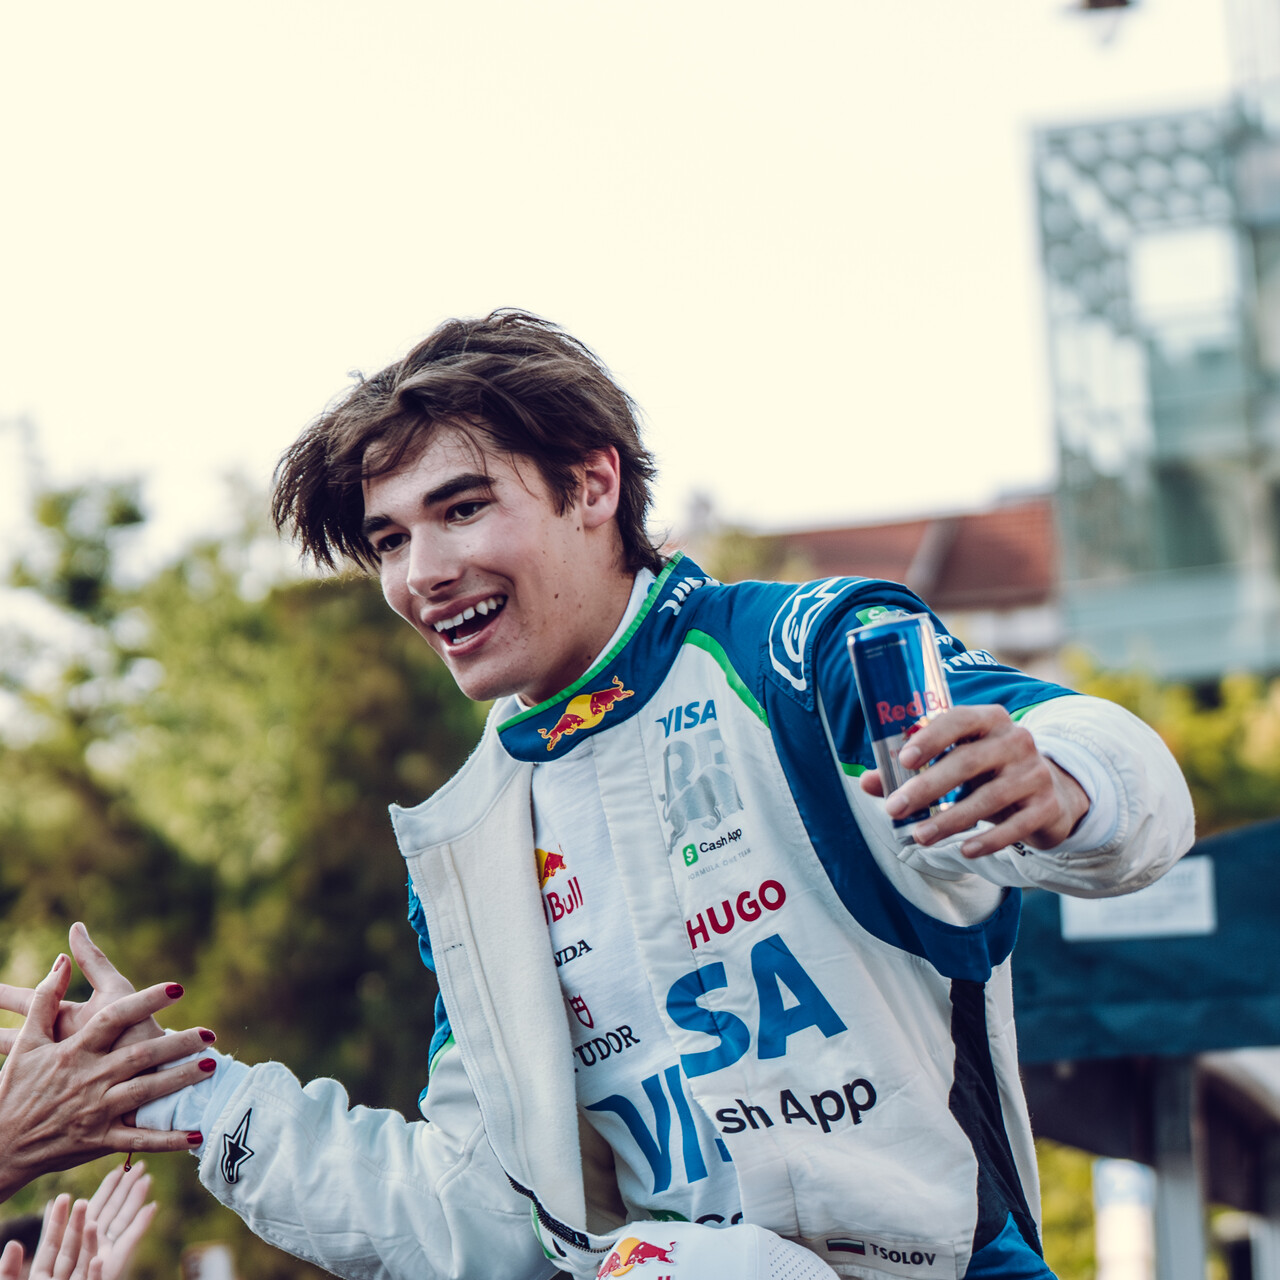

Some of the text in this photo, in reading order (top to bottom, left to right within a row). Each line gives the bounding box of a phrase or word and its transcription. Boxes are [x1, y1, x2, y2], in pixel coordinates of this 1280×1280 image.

[655, 699, 718, 738] VISA
[876, 690, 924, 725] Red
[699, 828, 742, 853] Cash App
[546, 876, 584, 923] Bull
[686, 879, 787, 950] HUGO
[666, 933, 848, 1079] SA
[780, 1078, 877, 1133] App
[584, 1064, 733, 1195] VI
[869, 1243, 936, 1266] TSOLOV
